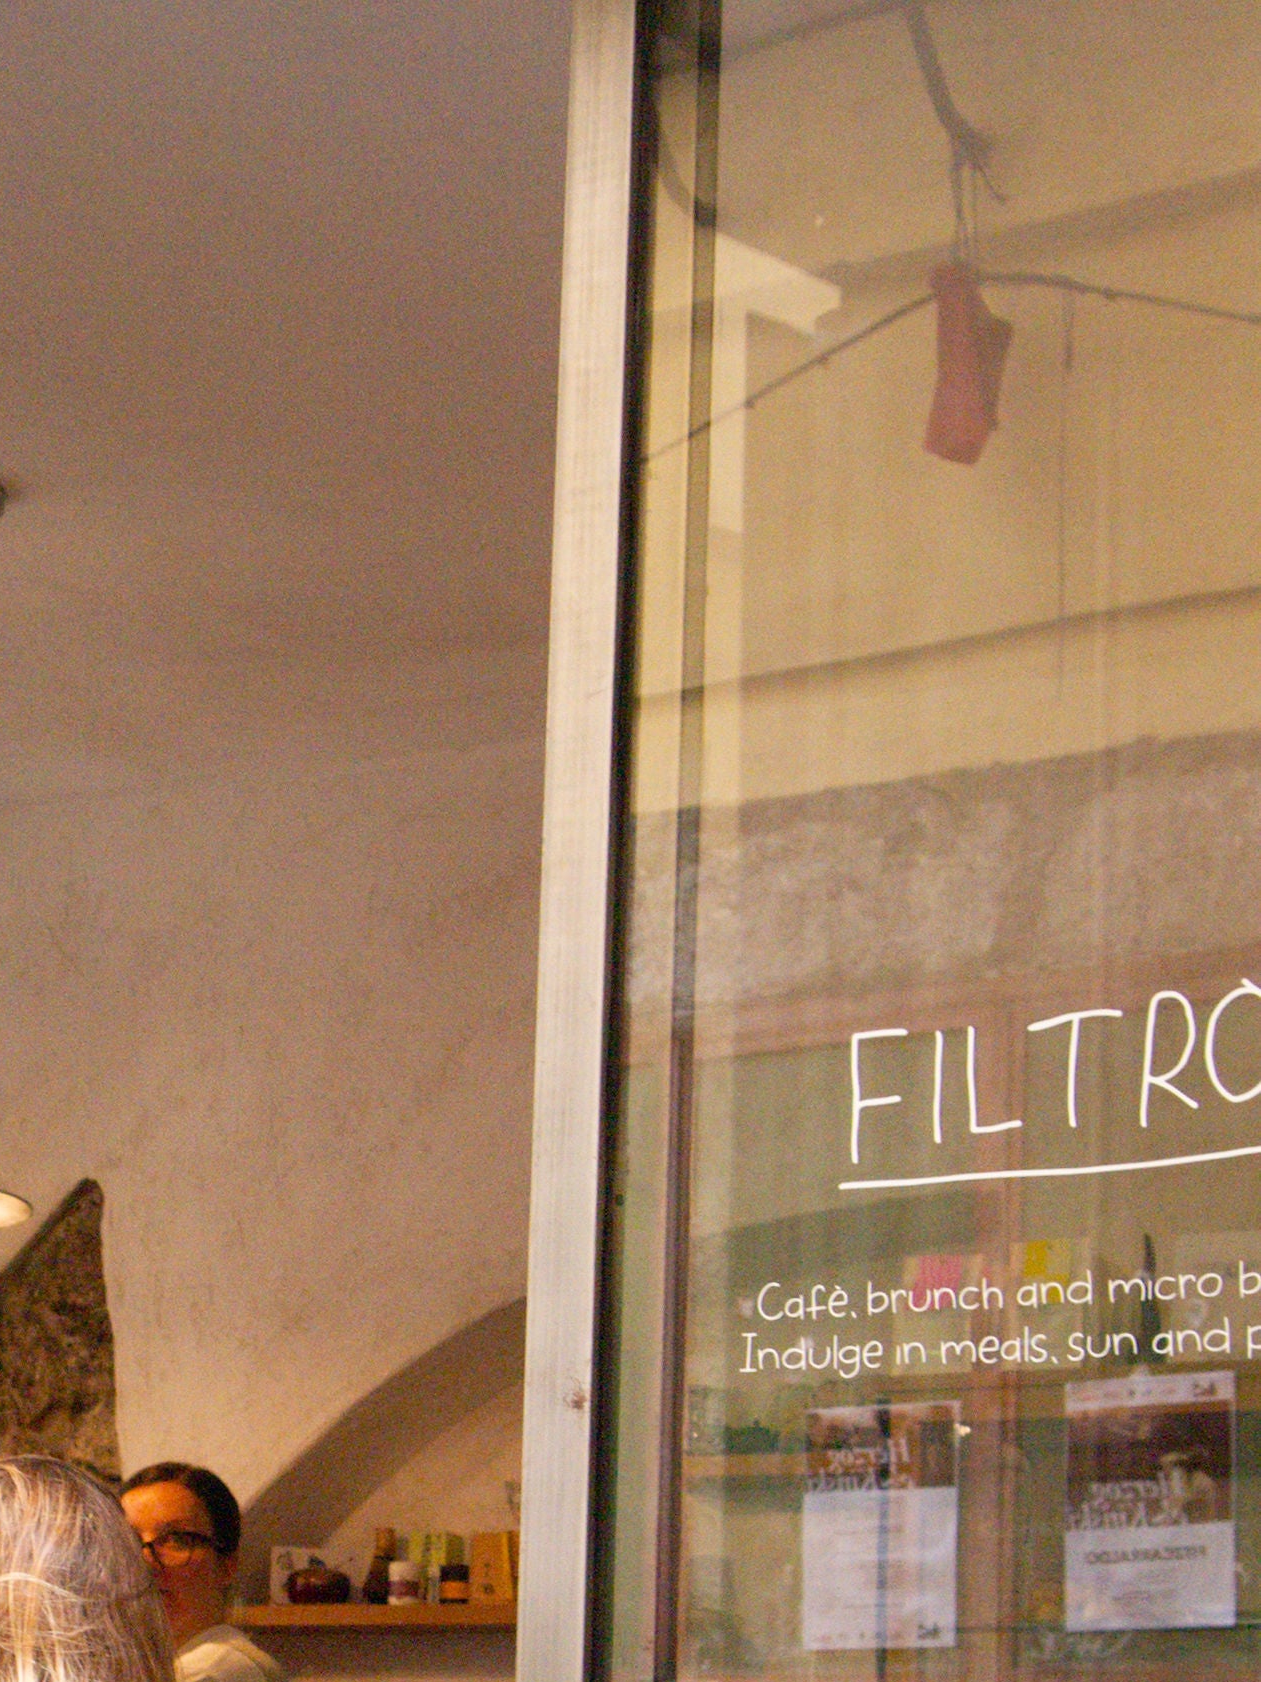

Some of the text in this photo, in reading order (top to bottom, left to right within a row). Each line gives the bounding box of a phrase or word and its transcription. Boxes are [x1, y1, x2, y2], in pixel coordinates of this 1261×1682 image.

[851, 978, 1261, 1164] FILTRO
[867, 1277, 1004, 1317] brunch
[1016, 1268, 1094, 1309] and
[1107, 1271, 1224, 1304] micro
[738, 1331, 884, 1379] Indulge
[895, 1340, 928, 1366] in
[1066, 1331, 1139, 1363] sun
[1151, 1315, 1232, 1358] and
